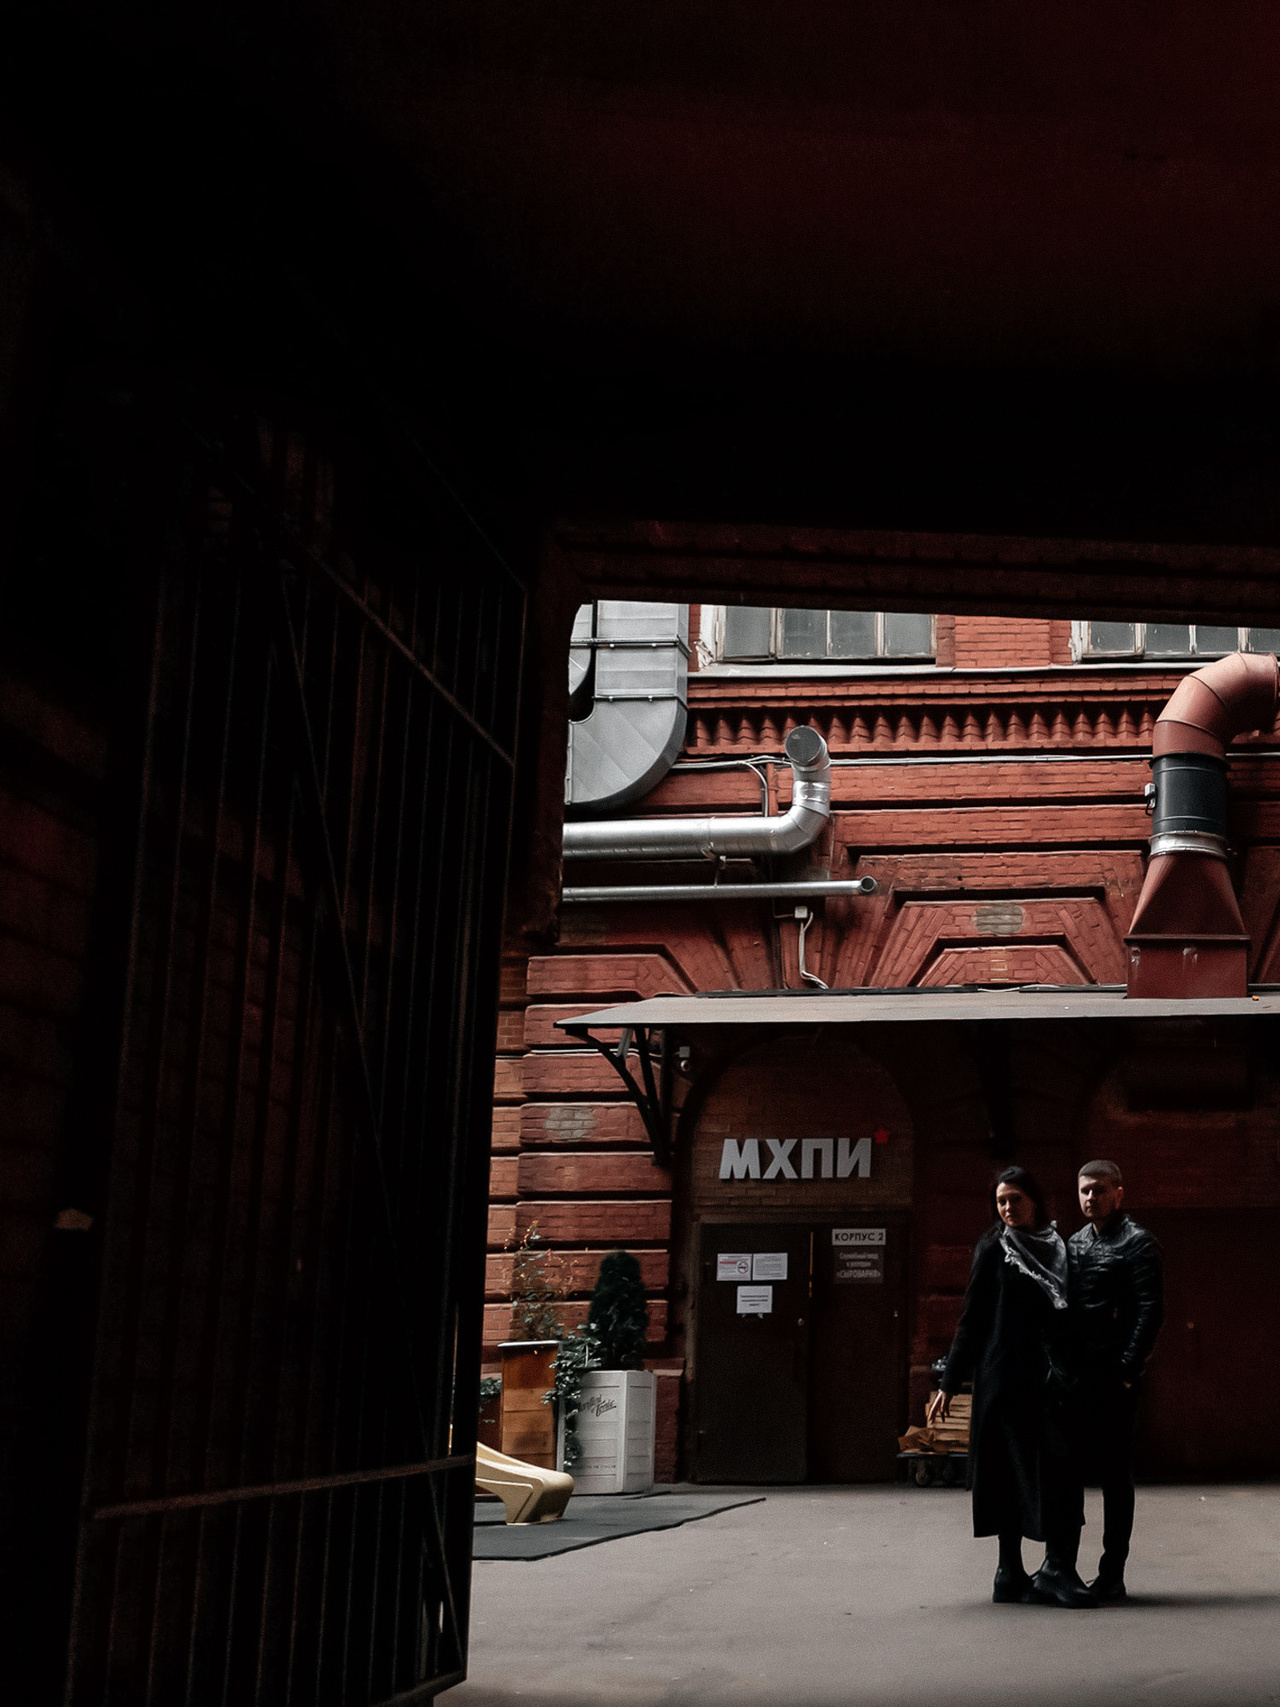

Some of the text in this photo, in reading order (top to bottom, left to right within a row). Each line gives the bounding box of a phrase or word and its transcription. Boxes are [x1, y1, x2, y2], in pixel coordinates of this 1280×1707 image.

[718, 1138, 872, 1179] МХПИ
[834, 1232, 884, 1241] КОРПУС 2
